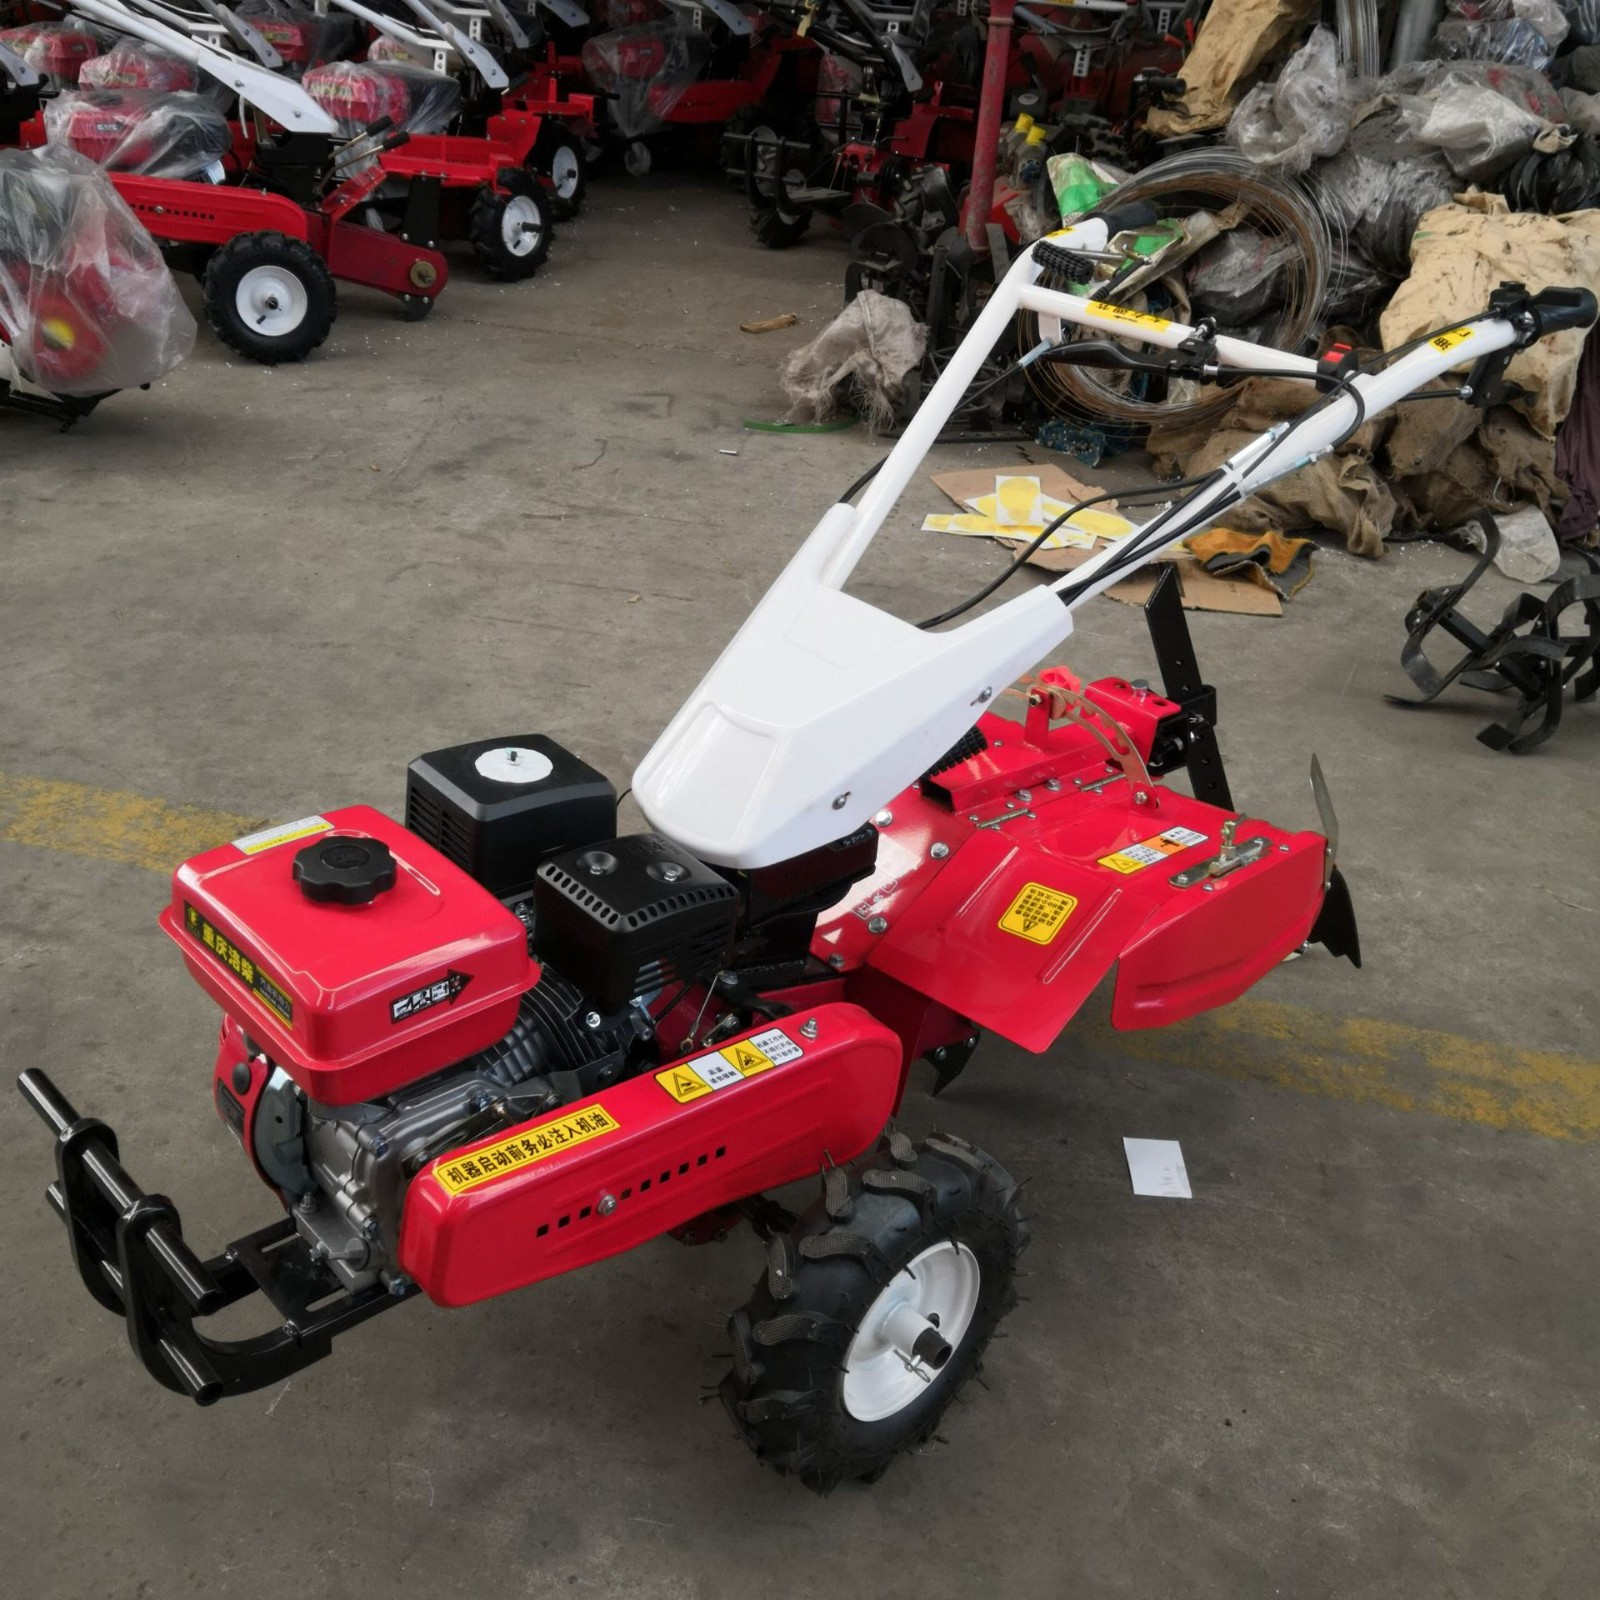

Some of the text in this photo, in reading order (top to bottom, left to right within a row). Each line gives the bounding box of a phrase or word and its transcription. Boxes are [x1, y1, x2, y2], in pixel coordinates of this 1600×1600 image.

[447, 1112, 608, 1184] 机器启动前务必注入机油
